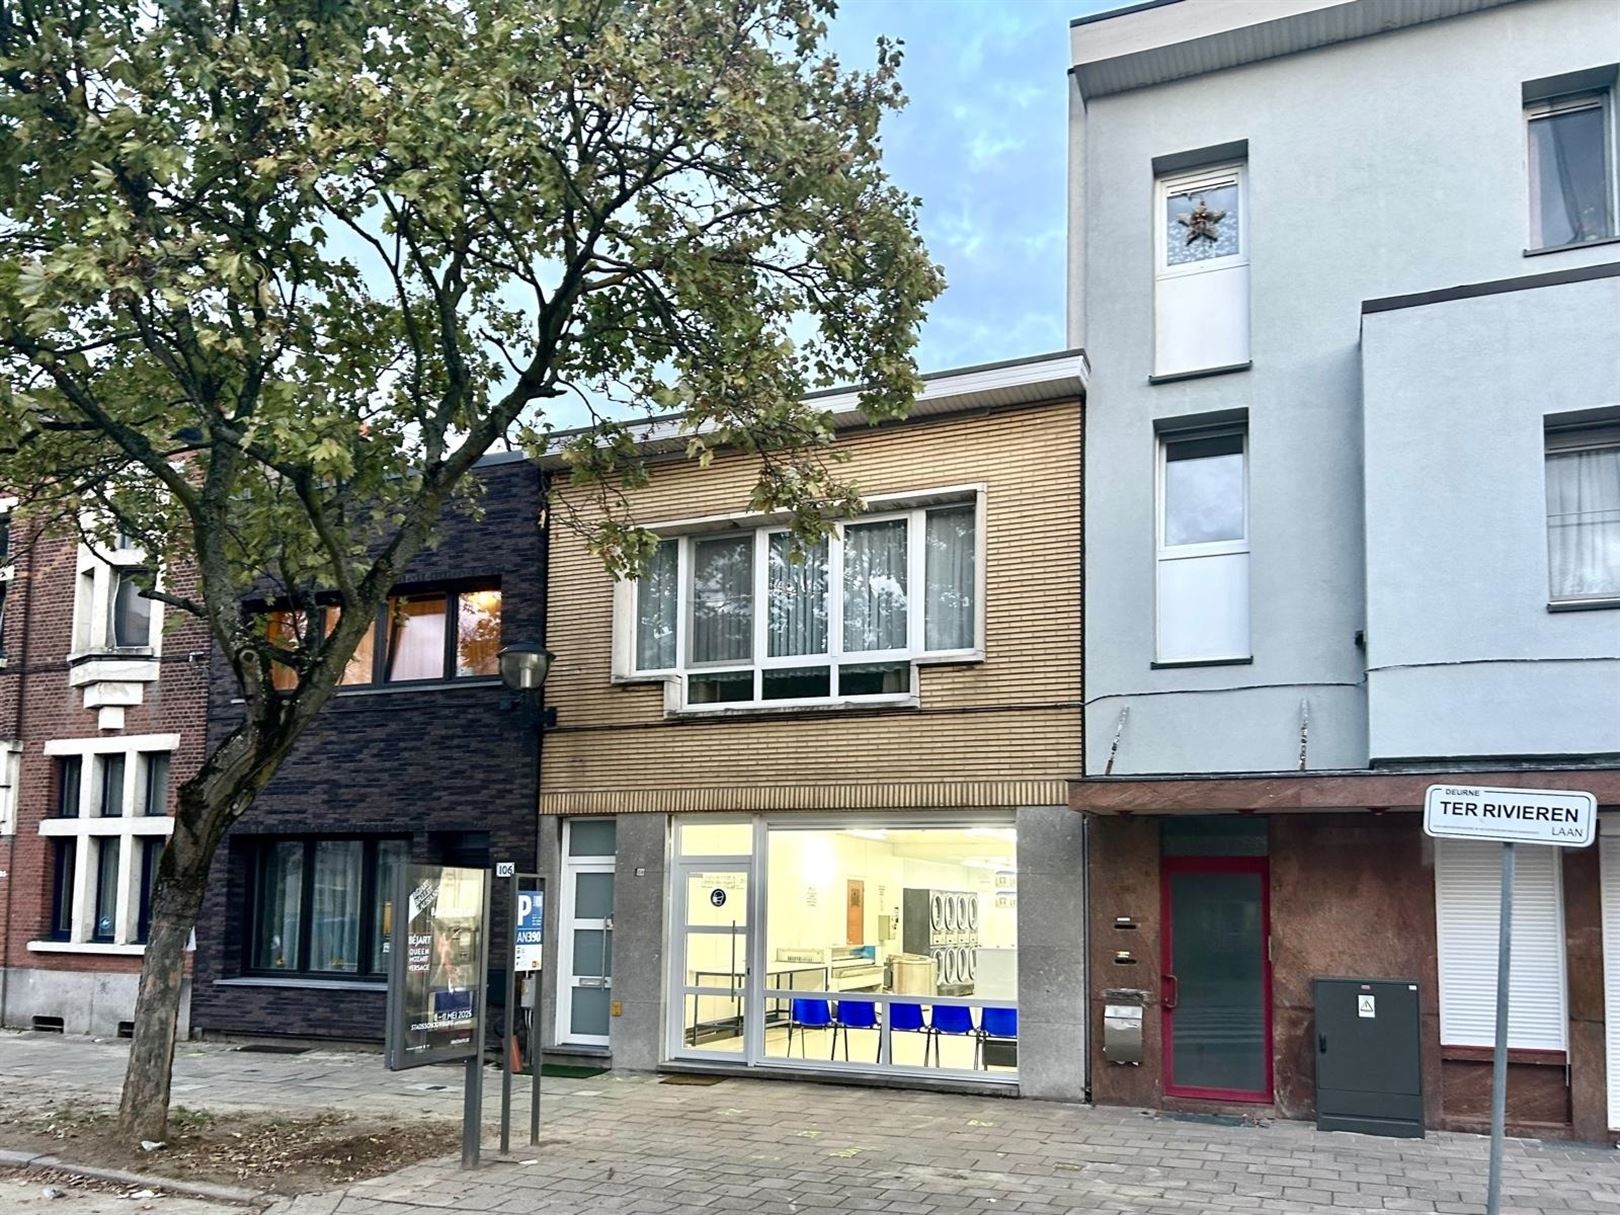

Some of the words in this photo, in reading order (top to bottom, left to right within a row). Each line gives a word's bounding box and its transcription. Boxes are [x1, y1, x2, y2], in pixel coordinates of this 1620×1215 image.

[1445, 788, 1480, 797] DEURNE
[1440, 801, 1478, 816] TER
[1483, 803, 1579, 823] RIVIEREN
[1551, 826, 1583, 838] LAAN
[499, 865, 513, 875] 106
[517, 894, 532, 926] P
[516, 931, 542, 943] AN390
